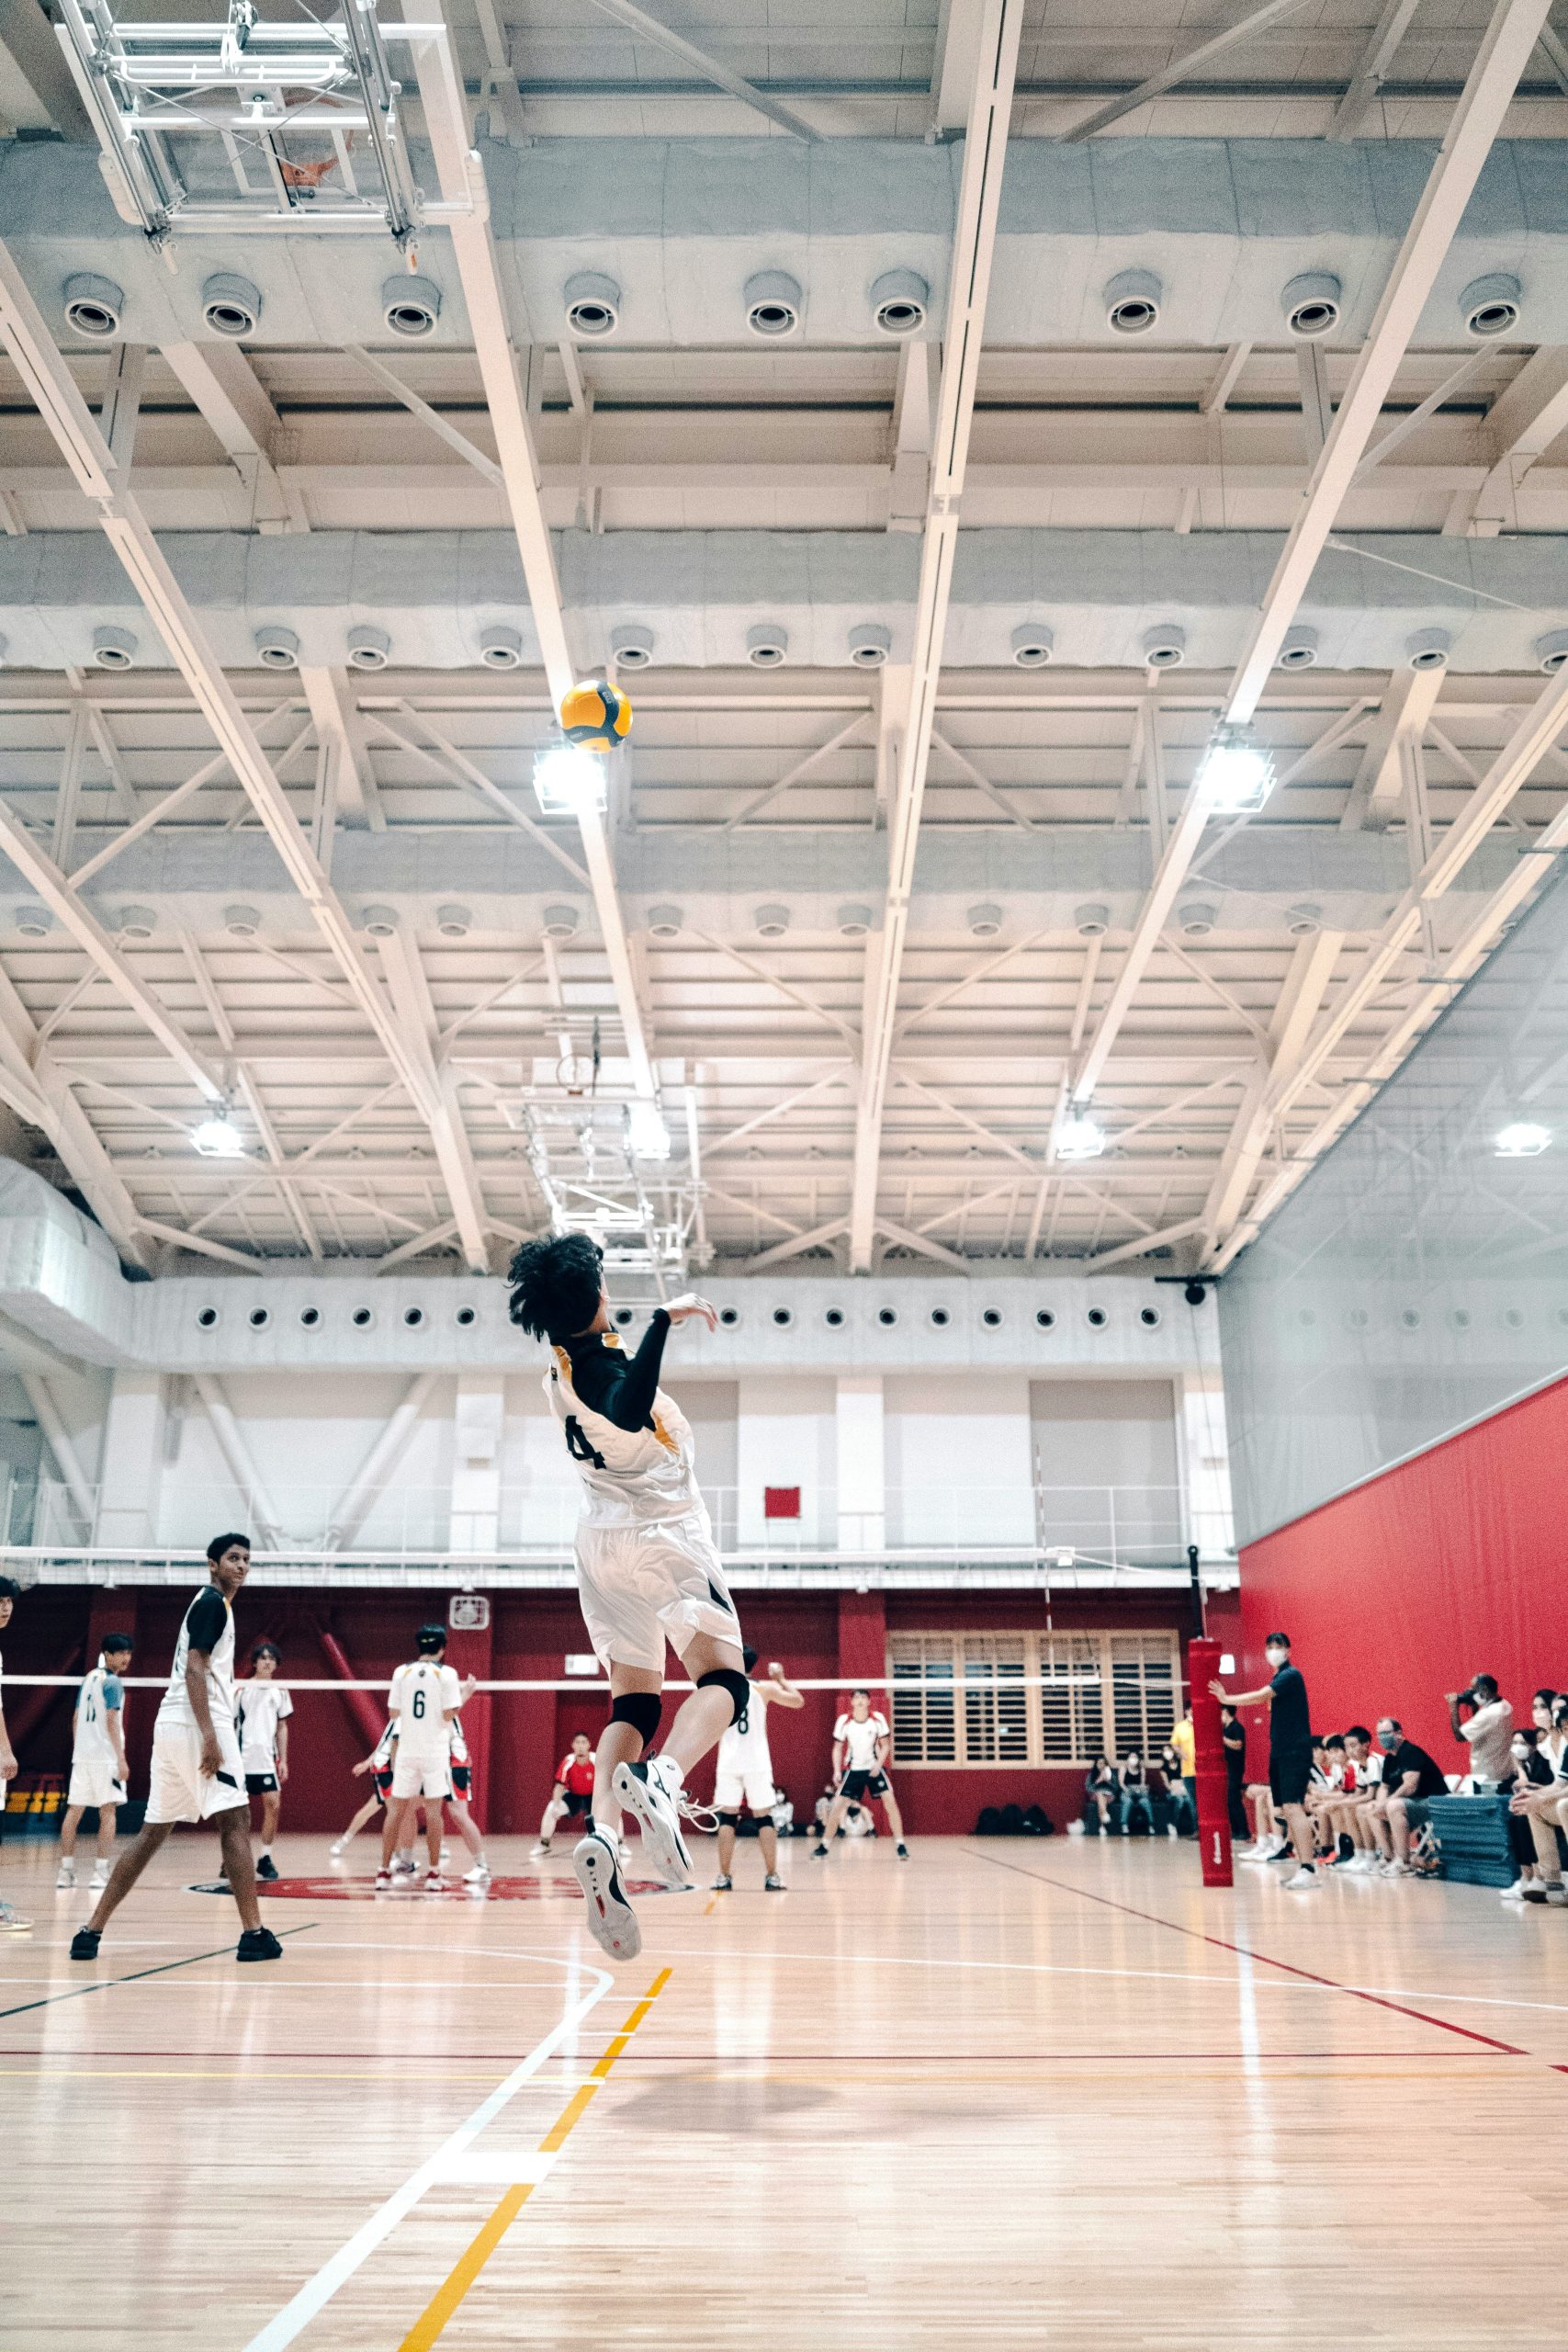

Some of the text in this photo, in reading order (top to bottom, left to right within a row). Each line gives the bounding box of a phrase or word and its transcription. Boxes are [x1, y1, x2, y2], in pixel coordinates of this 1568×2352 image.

[565, 1415, 606, 1469] 4
[413, 1690, 425, 1719] 6
[738, 1707, 749, 1735] 8
